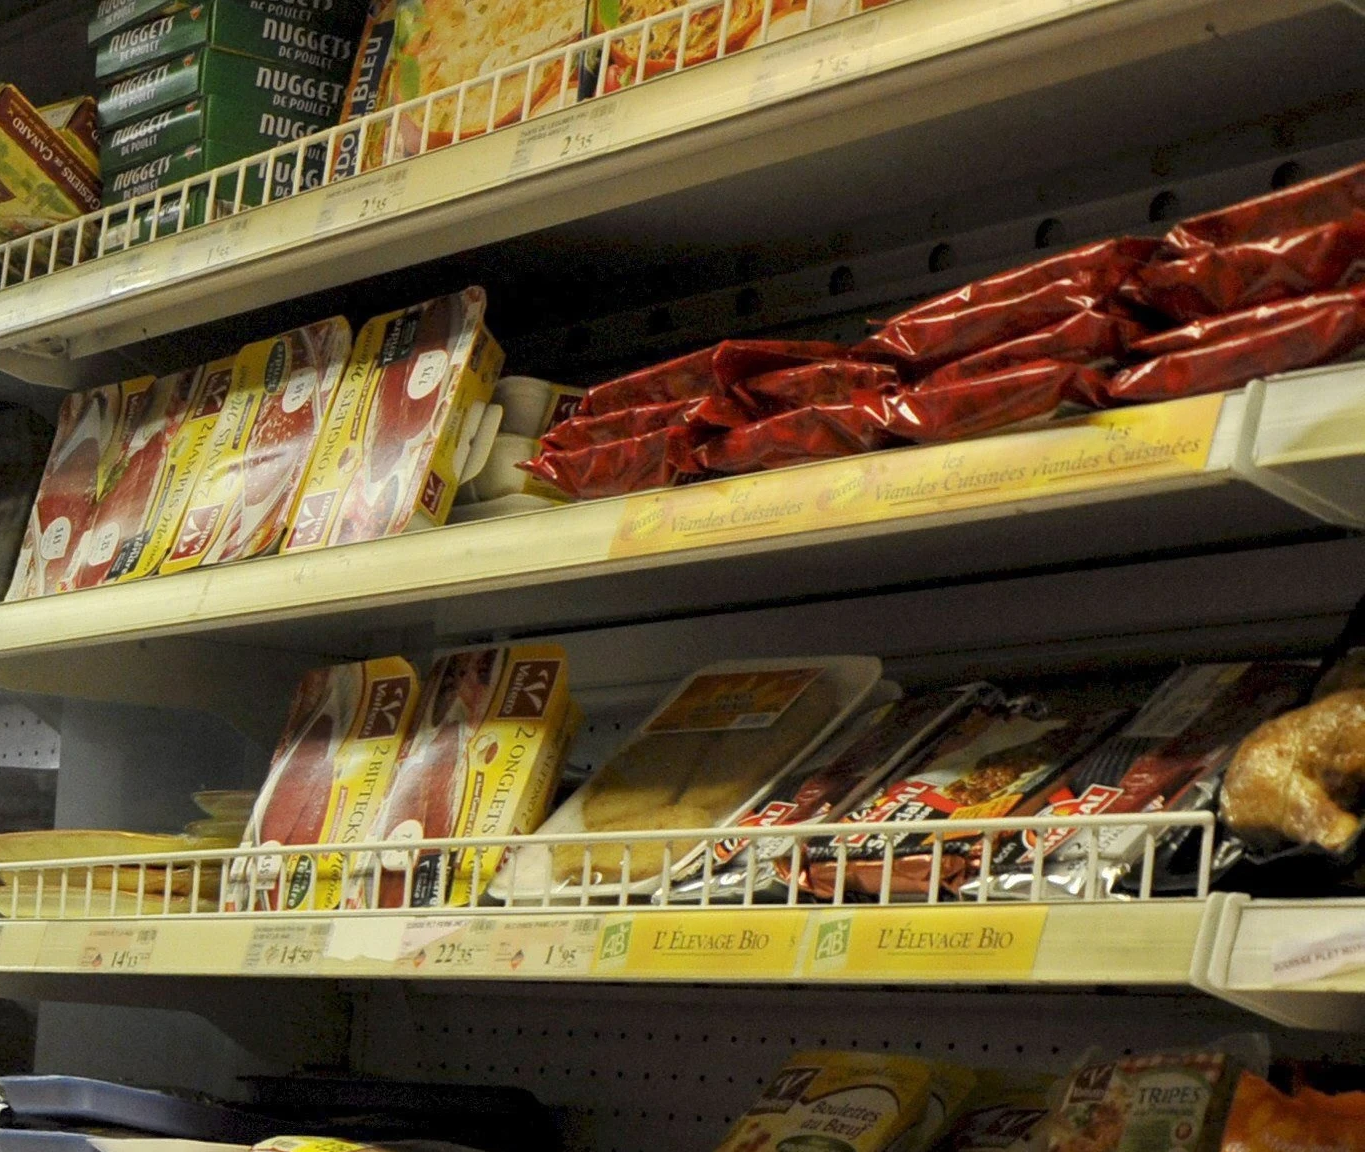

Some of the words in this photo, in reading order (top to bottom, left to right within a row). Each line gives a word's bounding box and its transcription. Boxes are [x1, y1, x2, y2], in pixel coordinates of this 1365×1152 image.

[109, 15, 176, 55] NUGGETS
[262, 17, 352, 61] NUGGETS
[293, 49, 334, 70] POULET
[352, 35, 383, 101] BLEU
[109, 63, 170, 105] NUGGETS
[256, 66, 345, 105] NUGGET
[288, 97, 333, 118] POULET
[12, 116, 54, 161] CANARD
[111, 110, 173, 149] NUGGETS
[113, 155, 172, 193] NUGGETS
[1106, 434, 1202, 469] Cuisinées
[482, 743, 522, 835] ONGLETS
[818, 933, 846, 958] AB
[1136, 1084, 1205, 1105] TRIPES
